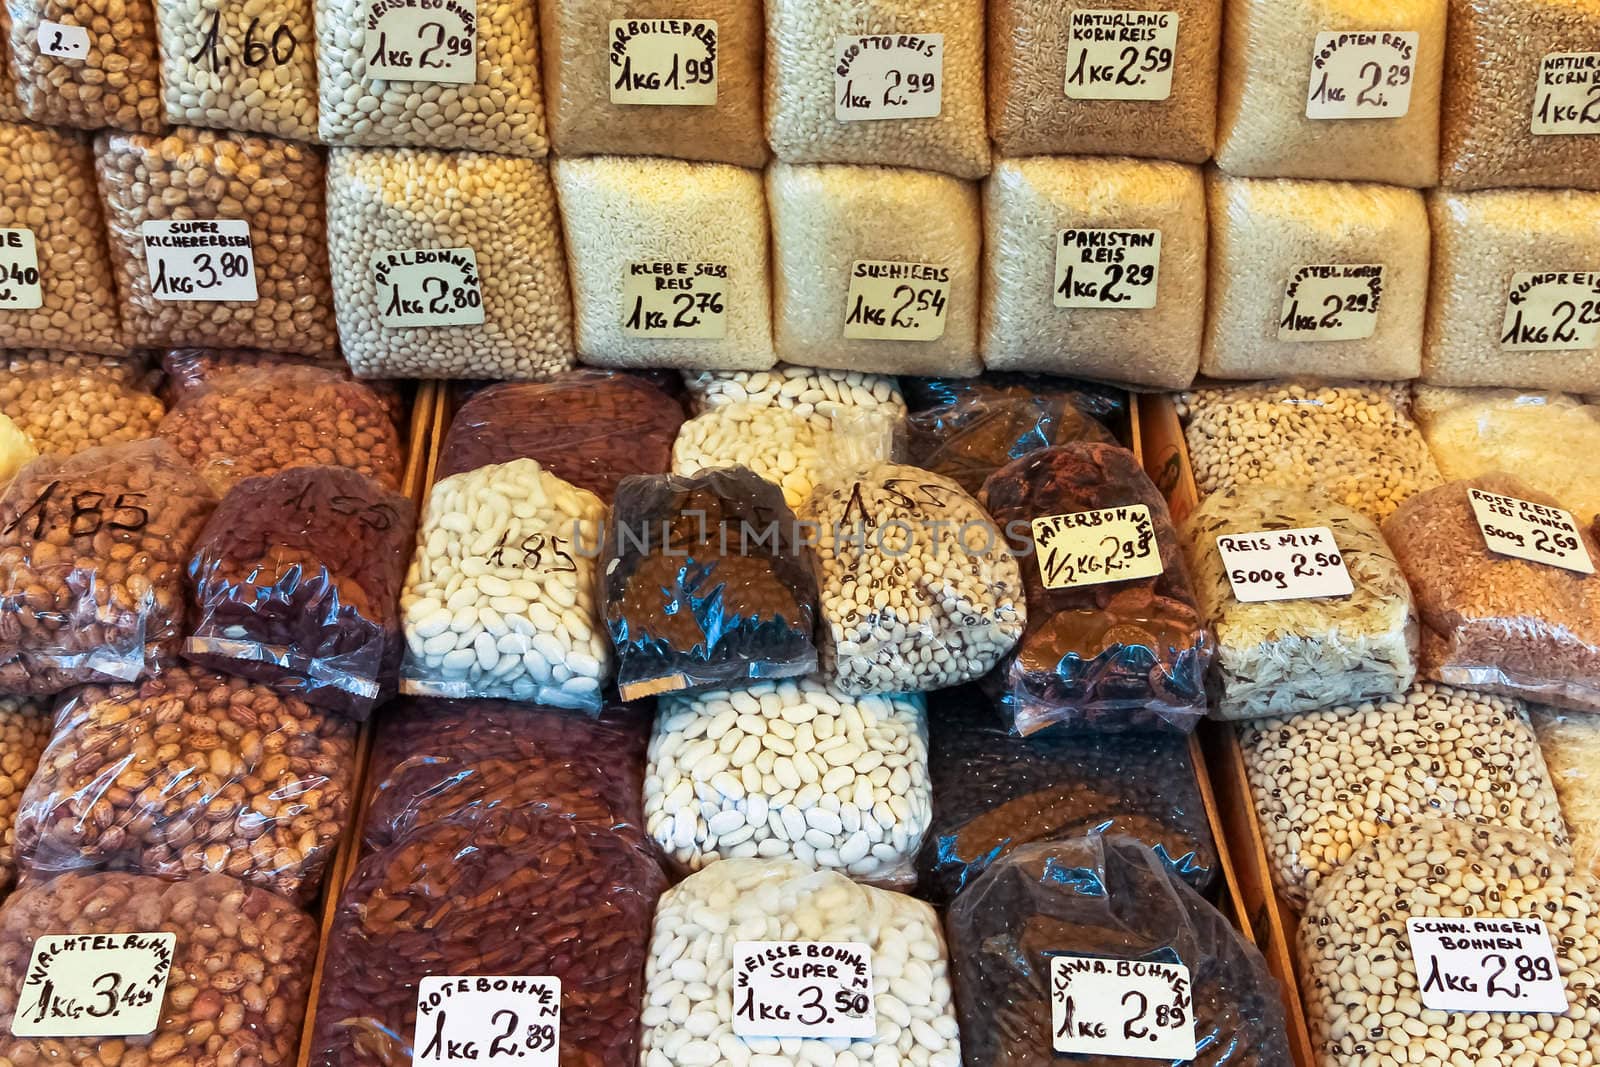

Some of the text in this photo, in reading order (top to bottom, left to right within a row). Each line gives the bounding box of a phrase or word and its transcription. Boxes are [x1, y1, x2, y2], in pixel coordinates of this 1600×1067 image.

[191, 9, 297, 73] 1.60
[418, 22, 473, 68] 2.99
[1382, 33, 1412, 60] REIS
[664, 53, 714, 91] 1.99
[1115, 46, 1172, 86] 2.59
[1357, 61, 1410, 106] 2.29
[884, 70, 935, 106] 2.99
[145, 235, 251, 248] KICHERERBSEN
[169, 222, 219, 234] SUPER
[1063, 230, 1154, 248] PAKISTAN
[193, 252, 249, 288] 3.80
[1080, 247, 1126, 263] REIS
[422, 277, 480, 314] 2.80
[655, 276, 694, 290] REIS
[1099, 264, 1155, 302] 2.29
[891, 284, 946, 328] 2.54
[3, 480, 149, 540] 1.85
[1472, 490, 1562, 519] ROSE REIS
[1489, 504, 1574, 532] SRI LANKA
[486, 528, 577, 574] 1.85
[1100, 536, 1151, 574] 2.99
[1220, 533, 1322, 553] REIS MIX
[1484, 525, 1578, 557] 500g 2.69
[1232, 553, 1341, 589] 500g 2.50
[1438, 937, 1522, 950] BOHNEN
[1474, 921, 1541, 935] AUGEN
[771, 962, 839, 979] SUPER
[1481, 954, 1553, 998] 2.89
[797, 985, 870, 1025] 3.50
[1121, 990, 1186, 1041] 2.89
[489, 1009, 555, 1058] 2.89
